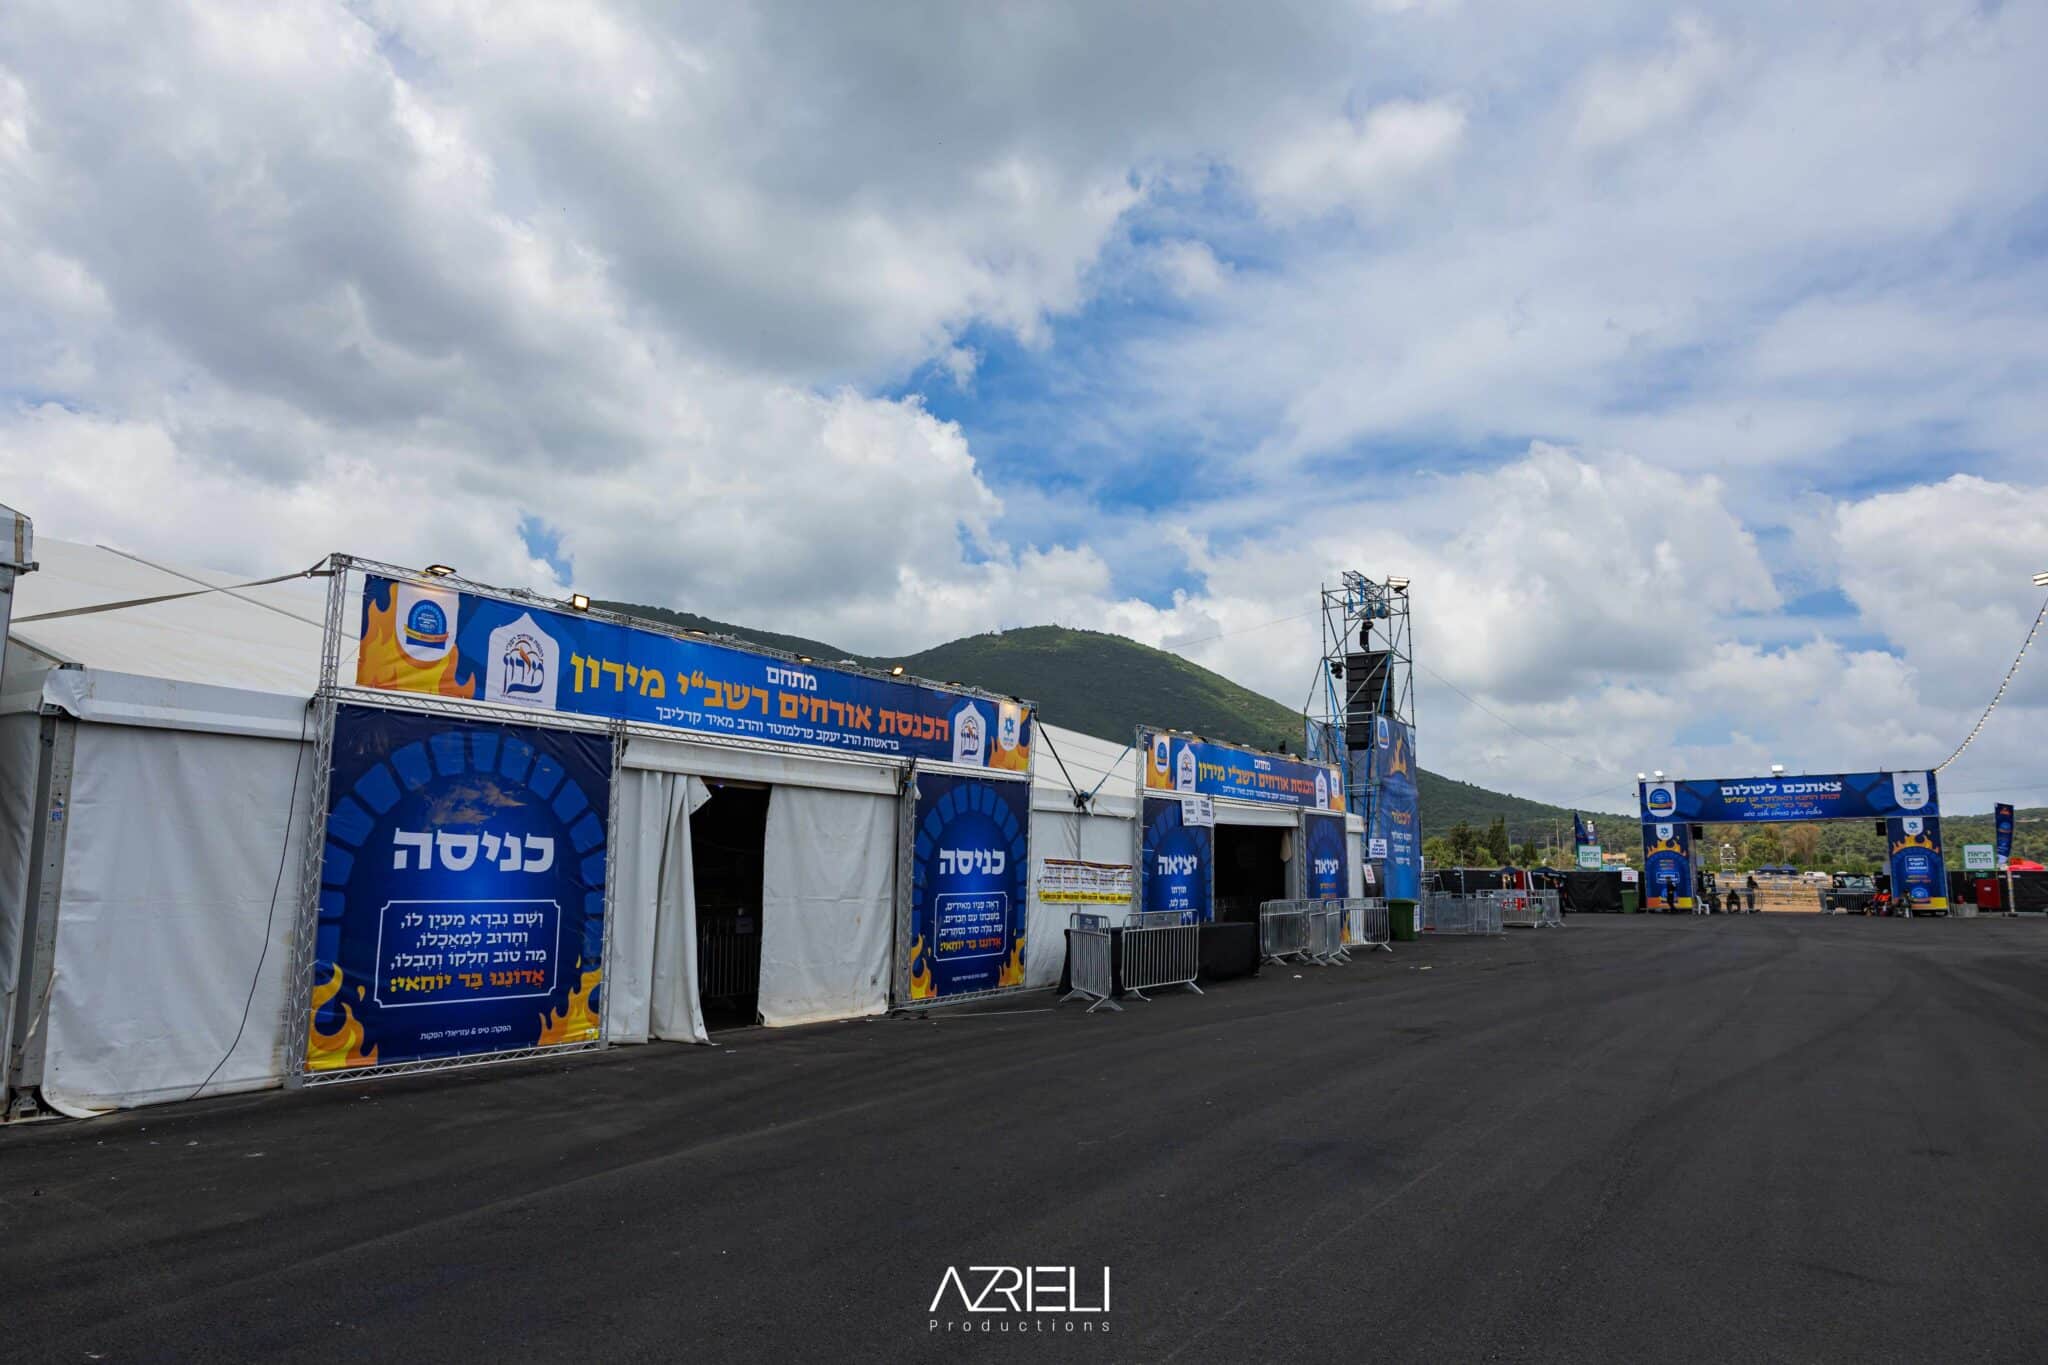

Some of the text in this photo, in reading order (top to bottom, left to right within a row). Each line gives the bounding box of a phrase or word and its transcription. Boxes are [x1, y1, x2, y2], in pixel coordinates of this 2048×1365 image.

[570, 651, 666, 699] מירון
[766, 665, 817, 692] מתחם
[778, 689, 872, 731] אורחים
[878, 706, 949, 742] הכנסת
[655, 706, 900, 751] בראשות הרב יעקב פרלמוטר והרב מאיר קרליבך
[1721, 781, 1842, 796] צאתכם לשלום
[392, 828, 555, 873] כניסה
[938, 847, 1006, 875] כניסה
[1158, 854, 1198, 876] יציאה
[1314, 857, 1339, 875] יציאה
